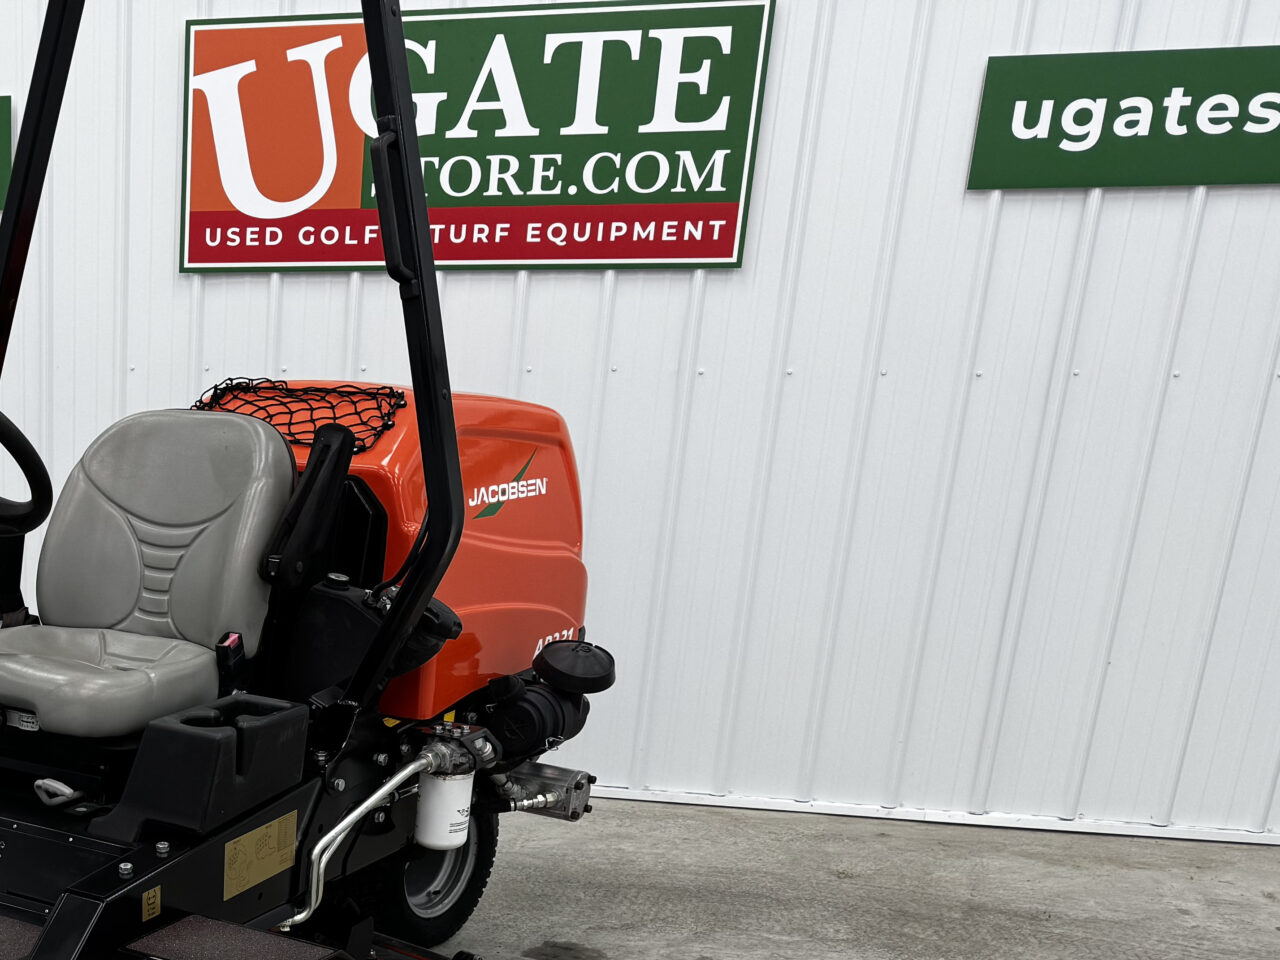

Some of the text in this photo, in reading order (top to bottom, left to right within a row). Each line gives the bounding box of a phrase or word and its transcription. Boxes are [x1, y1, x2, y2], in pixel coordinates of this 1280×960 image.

[1011, 86, 1280, 152] ugates
[371, 149, 731, 198] TORE.COM
[205, 220, 727, 247] USED GOLF TURF EQUIPMENT
[468, 477, 547, 507] JACOBSEN
